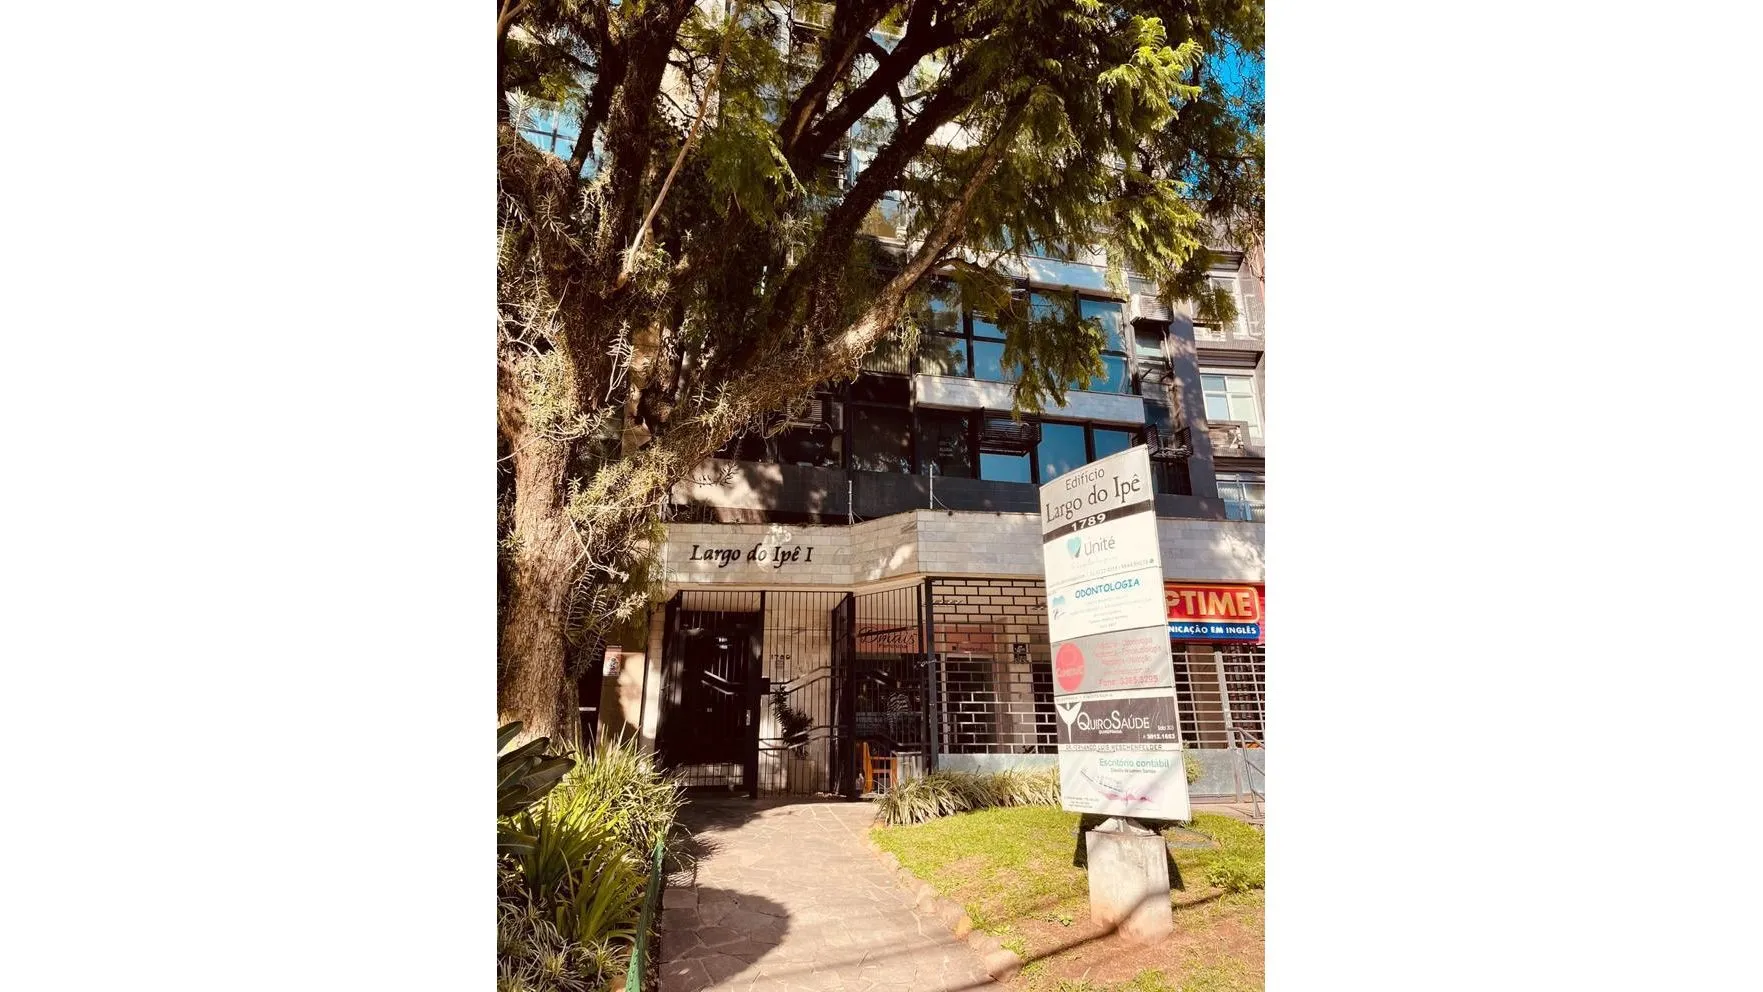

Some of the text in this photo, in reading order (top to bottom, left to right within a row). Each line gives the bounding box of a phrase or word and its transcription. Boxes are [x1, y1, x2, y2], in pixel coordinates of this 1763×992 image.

[1045, 473, 1140, 522] Largo do Ipê
[1071, 513, 1106, 531] 1789
[689, 542, 814, 568] Largo do Ipê I
[1084, 536, 1116, 556] Unité
[1074, 578, 1140, 599] ODONTOLOGIA
[1210, 626, 1224, 634] EM
[1226, 625, 1257, 634] INGLÊS
